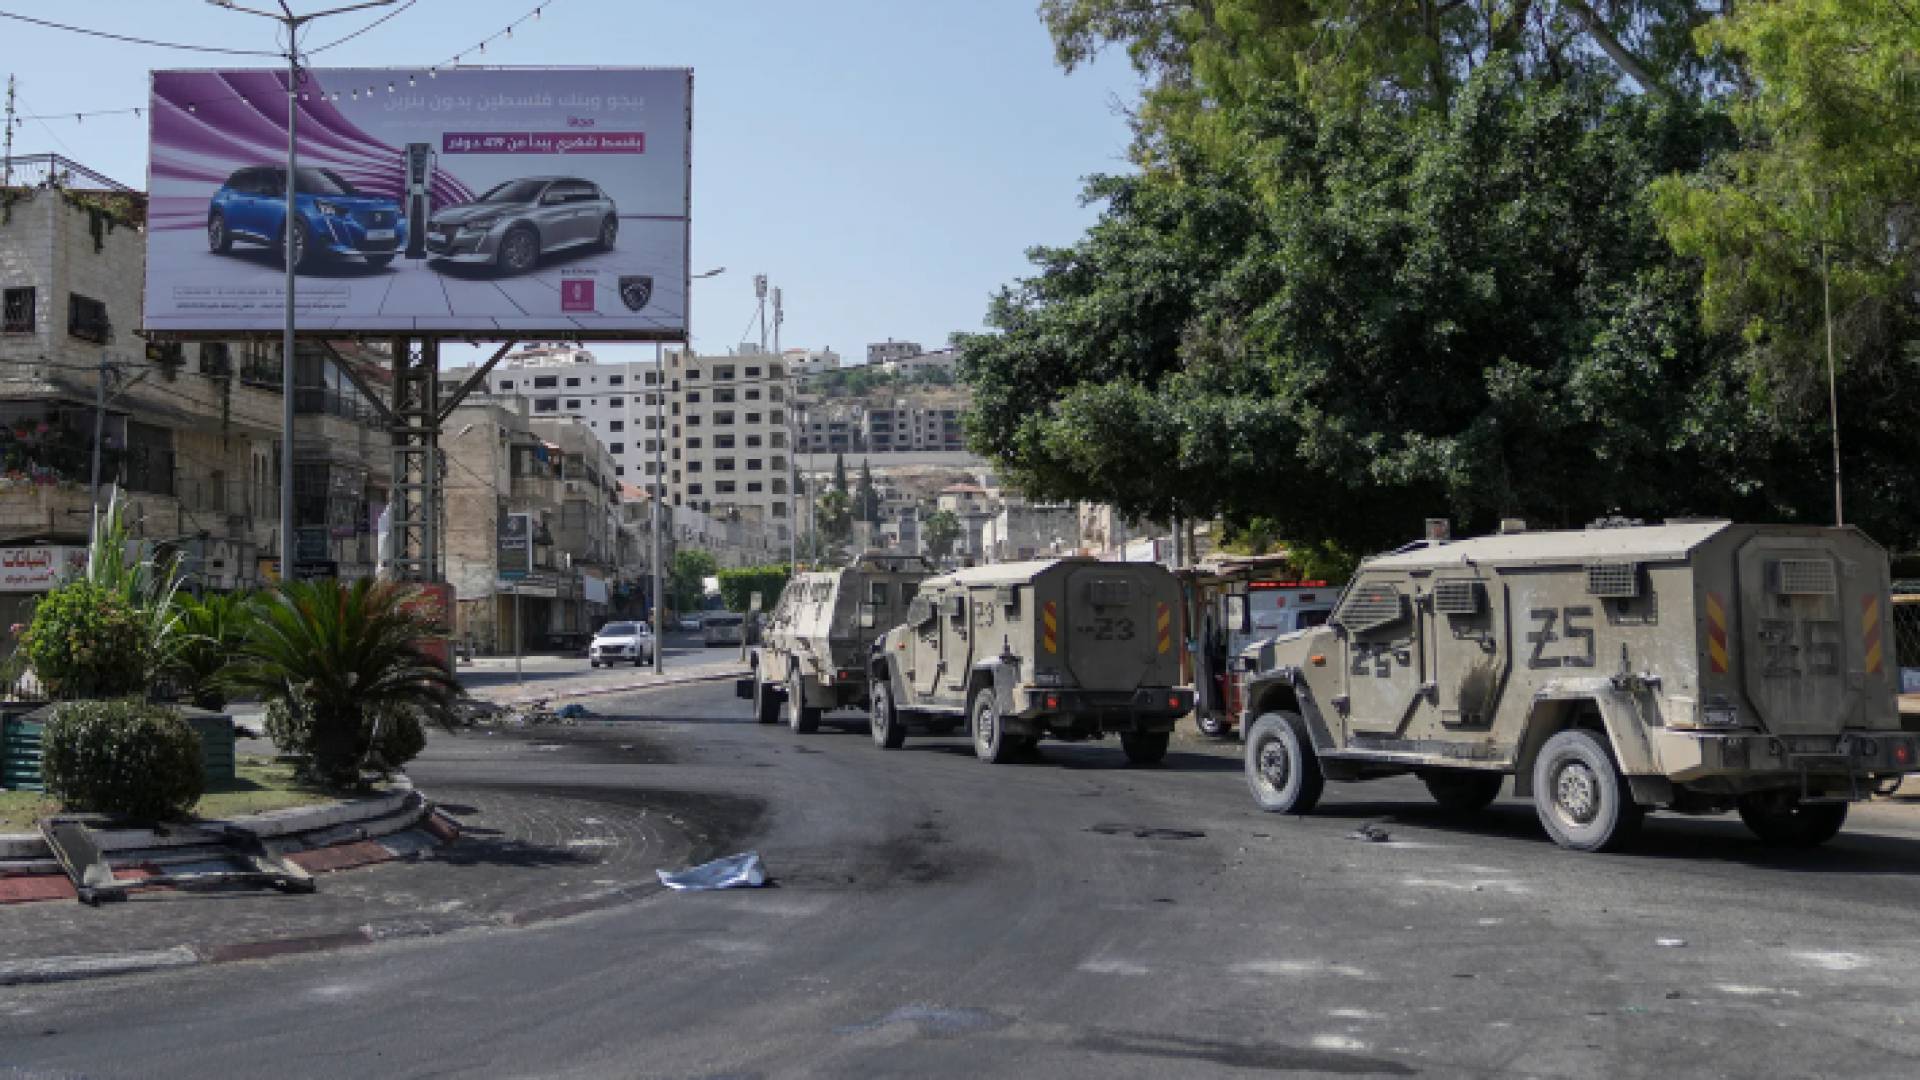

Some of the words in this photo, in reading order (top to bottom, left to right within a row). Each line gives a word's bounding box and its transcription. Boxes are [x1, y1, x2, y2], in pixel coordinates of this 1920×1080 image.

[383, 93, 425, 112] بنزين
[428, 93, 471, 111] بدون
[477, 93, 552, 111] فلسطين
[558, 93, 601, 111] وبنك
[607, 94, 645, 111] بيجو
[507, 136, 527, 151] من
[555, 136, 598, 154] شهري
[601, 137, 641, 151] بقسط
[1527, 606, 1596, 670] Z5
[1758, 618, 1841, 678] Z5
